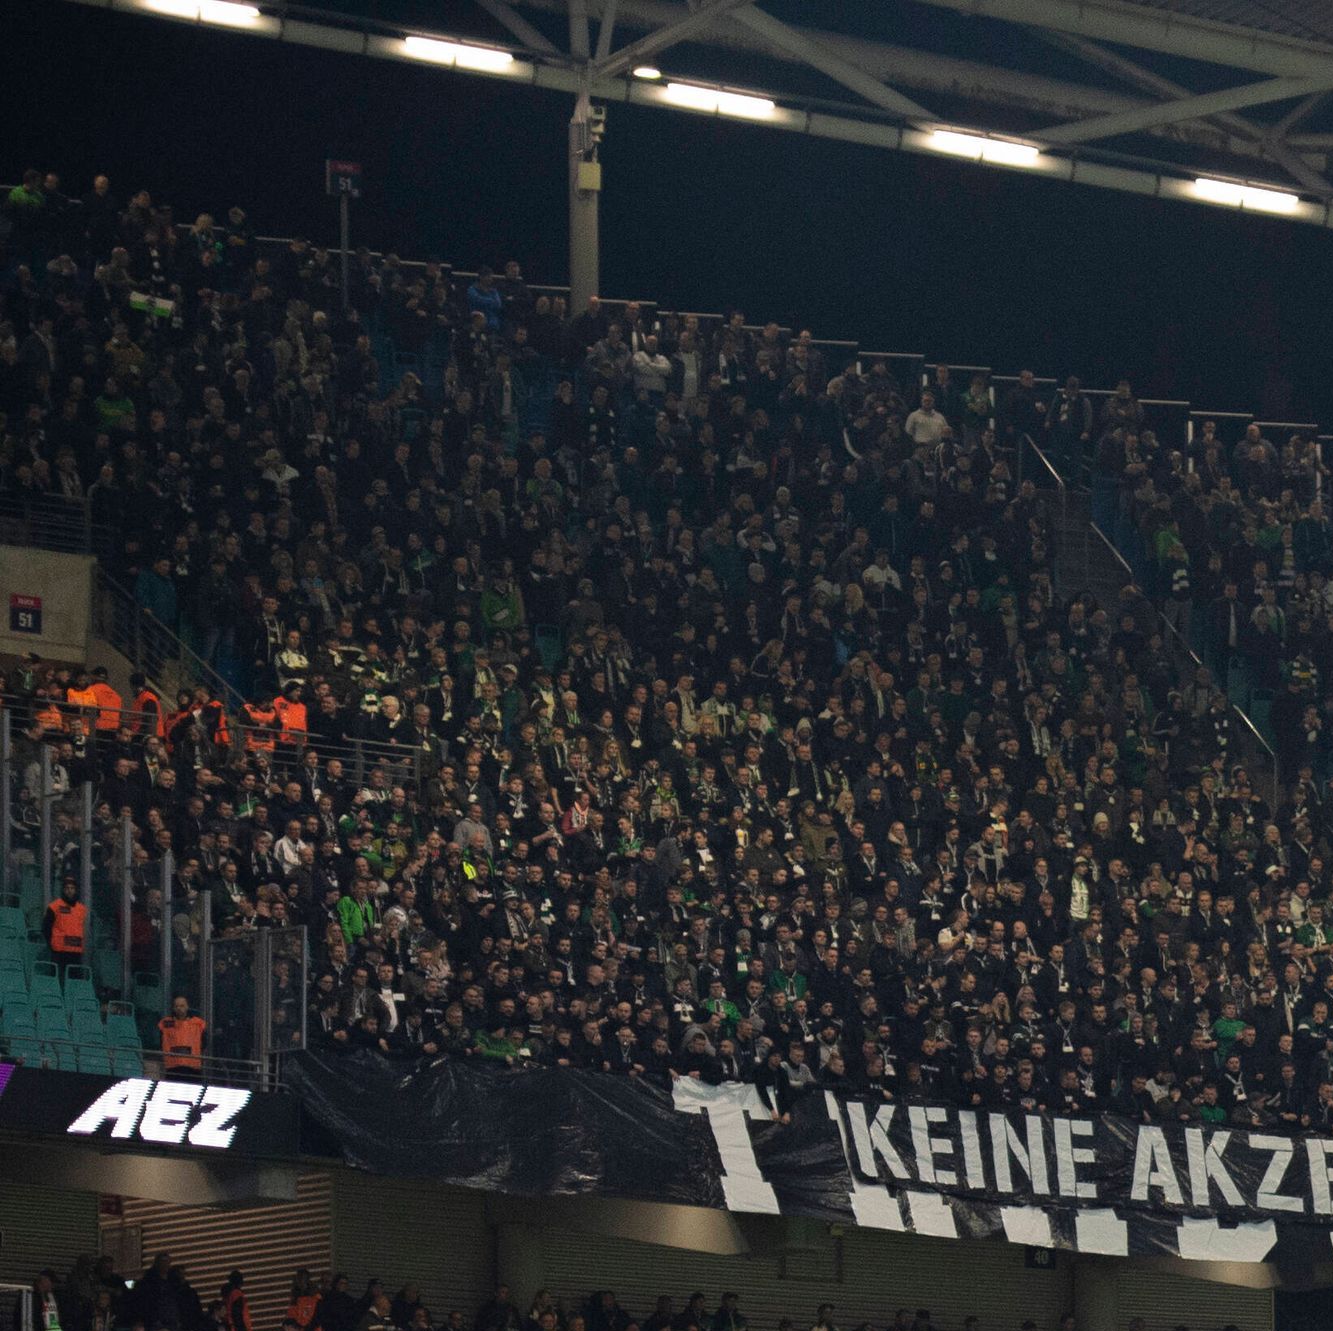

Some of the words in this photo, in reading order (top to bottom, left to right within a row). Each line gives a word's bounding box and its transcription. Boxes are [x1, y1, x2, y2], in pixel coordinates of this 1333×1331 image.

[18, 612, 33, 628] 51
[67, 1076, 252, 1148] AEZ
[847, 1100, 1099, 1198] KEINE
